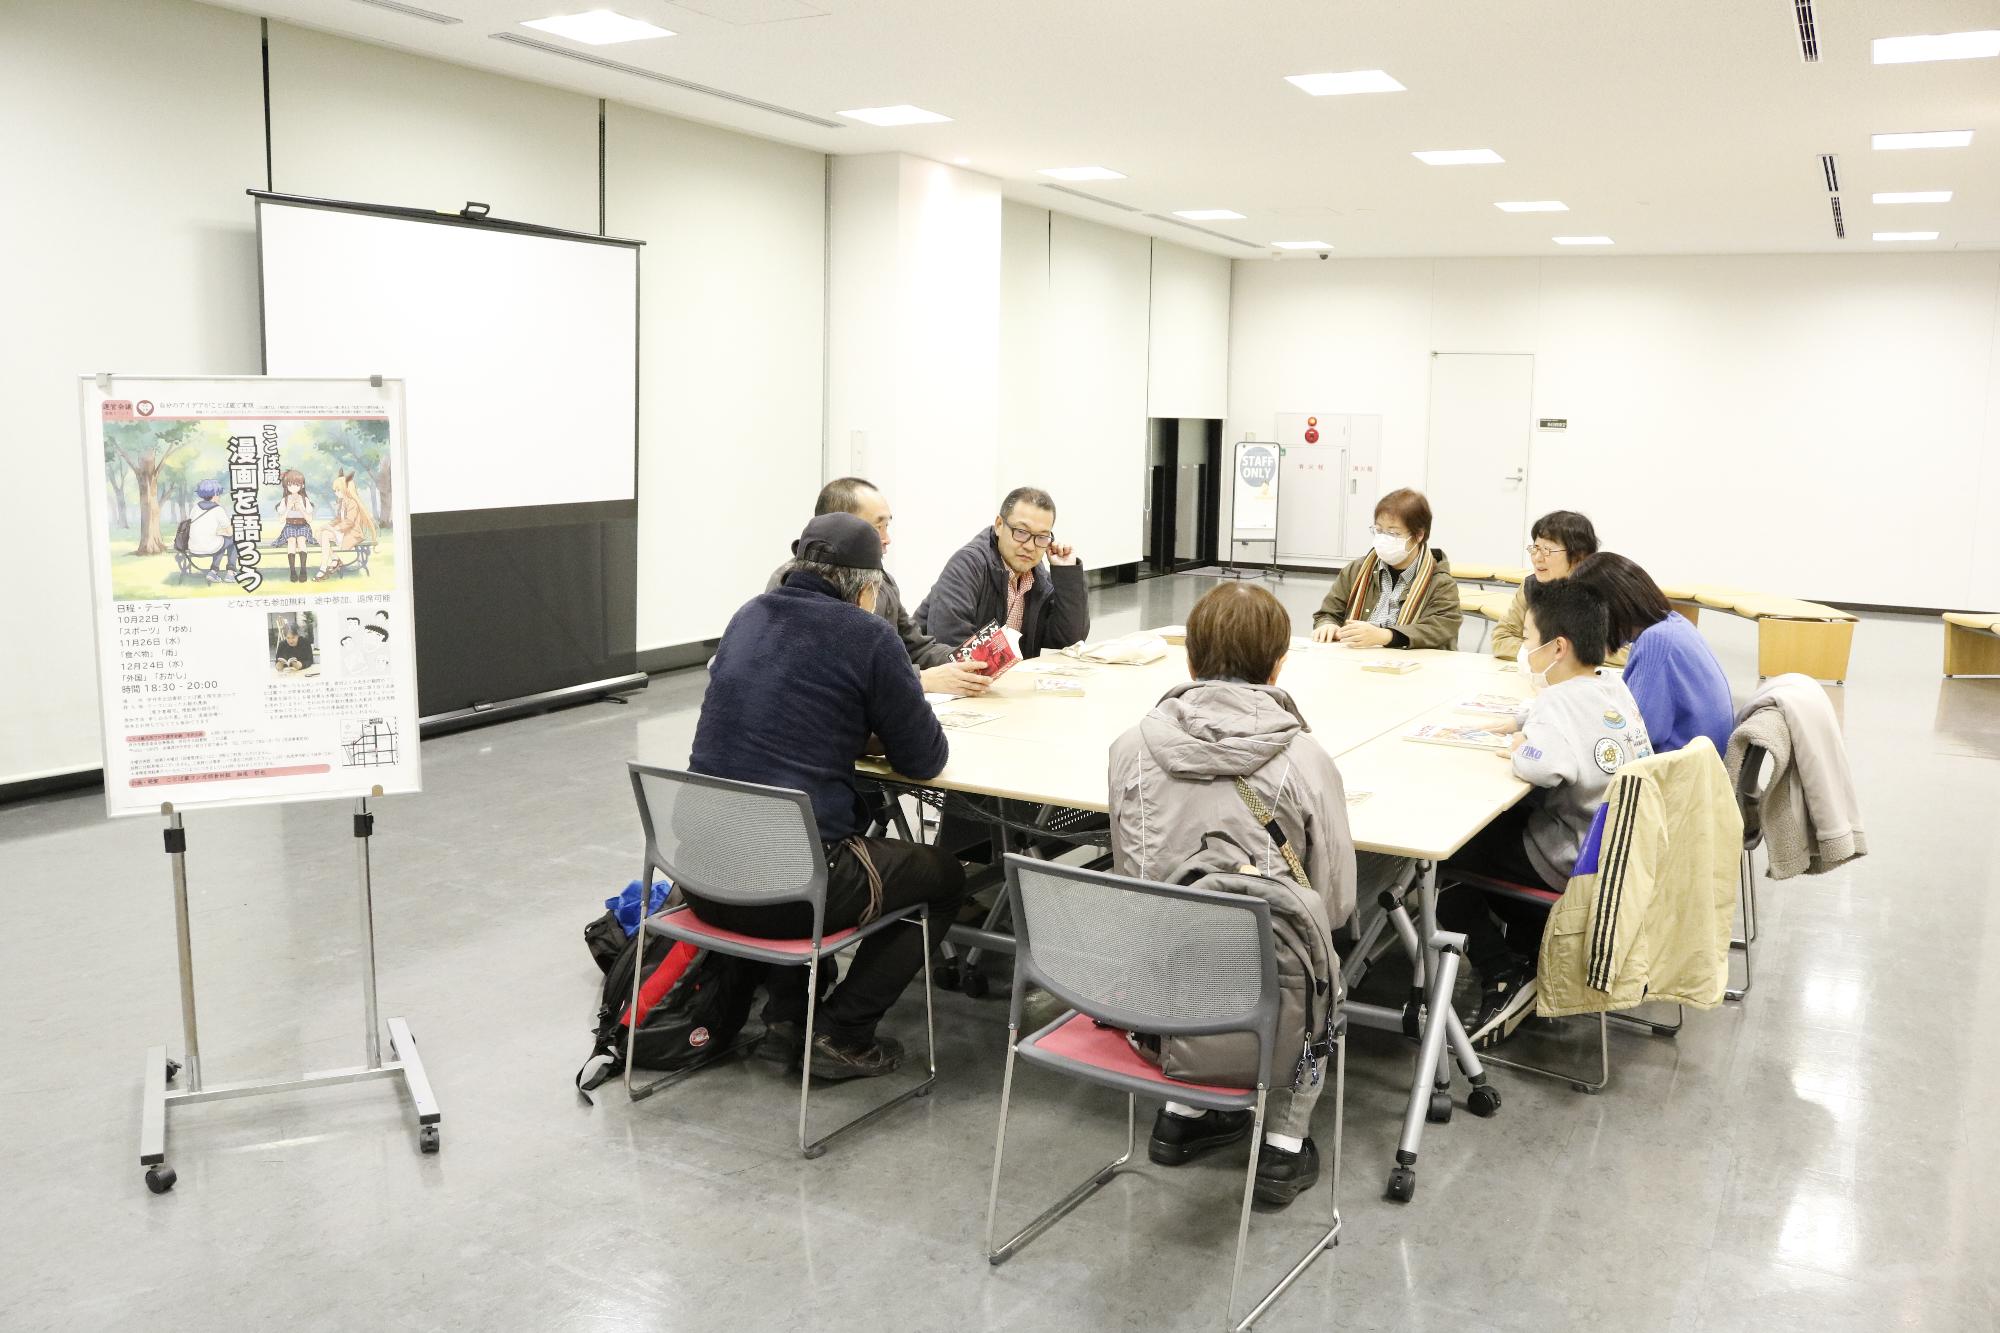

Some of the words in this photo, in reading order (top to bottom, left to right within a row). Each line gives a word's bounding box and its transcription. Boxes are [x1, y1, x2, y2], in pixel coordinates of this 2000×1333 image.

[263, 424, 281, 485] ことば蔵
[1242, 455, 1274, 467] STAFF
[1243, 467, 1271, 479] ONLY
[226, 436, 262, 593] 漫画を語ろう
[117, 603, 171, 613] 日程・テーマ
[121, 684, 141, 694] 時間
[145, 683, 176, 692] 18:30
[187, 680, 218, 690] 20:00
